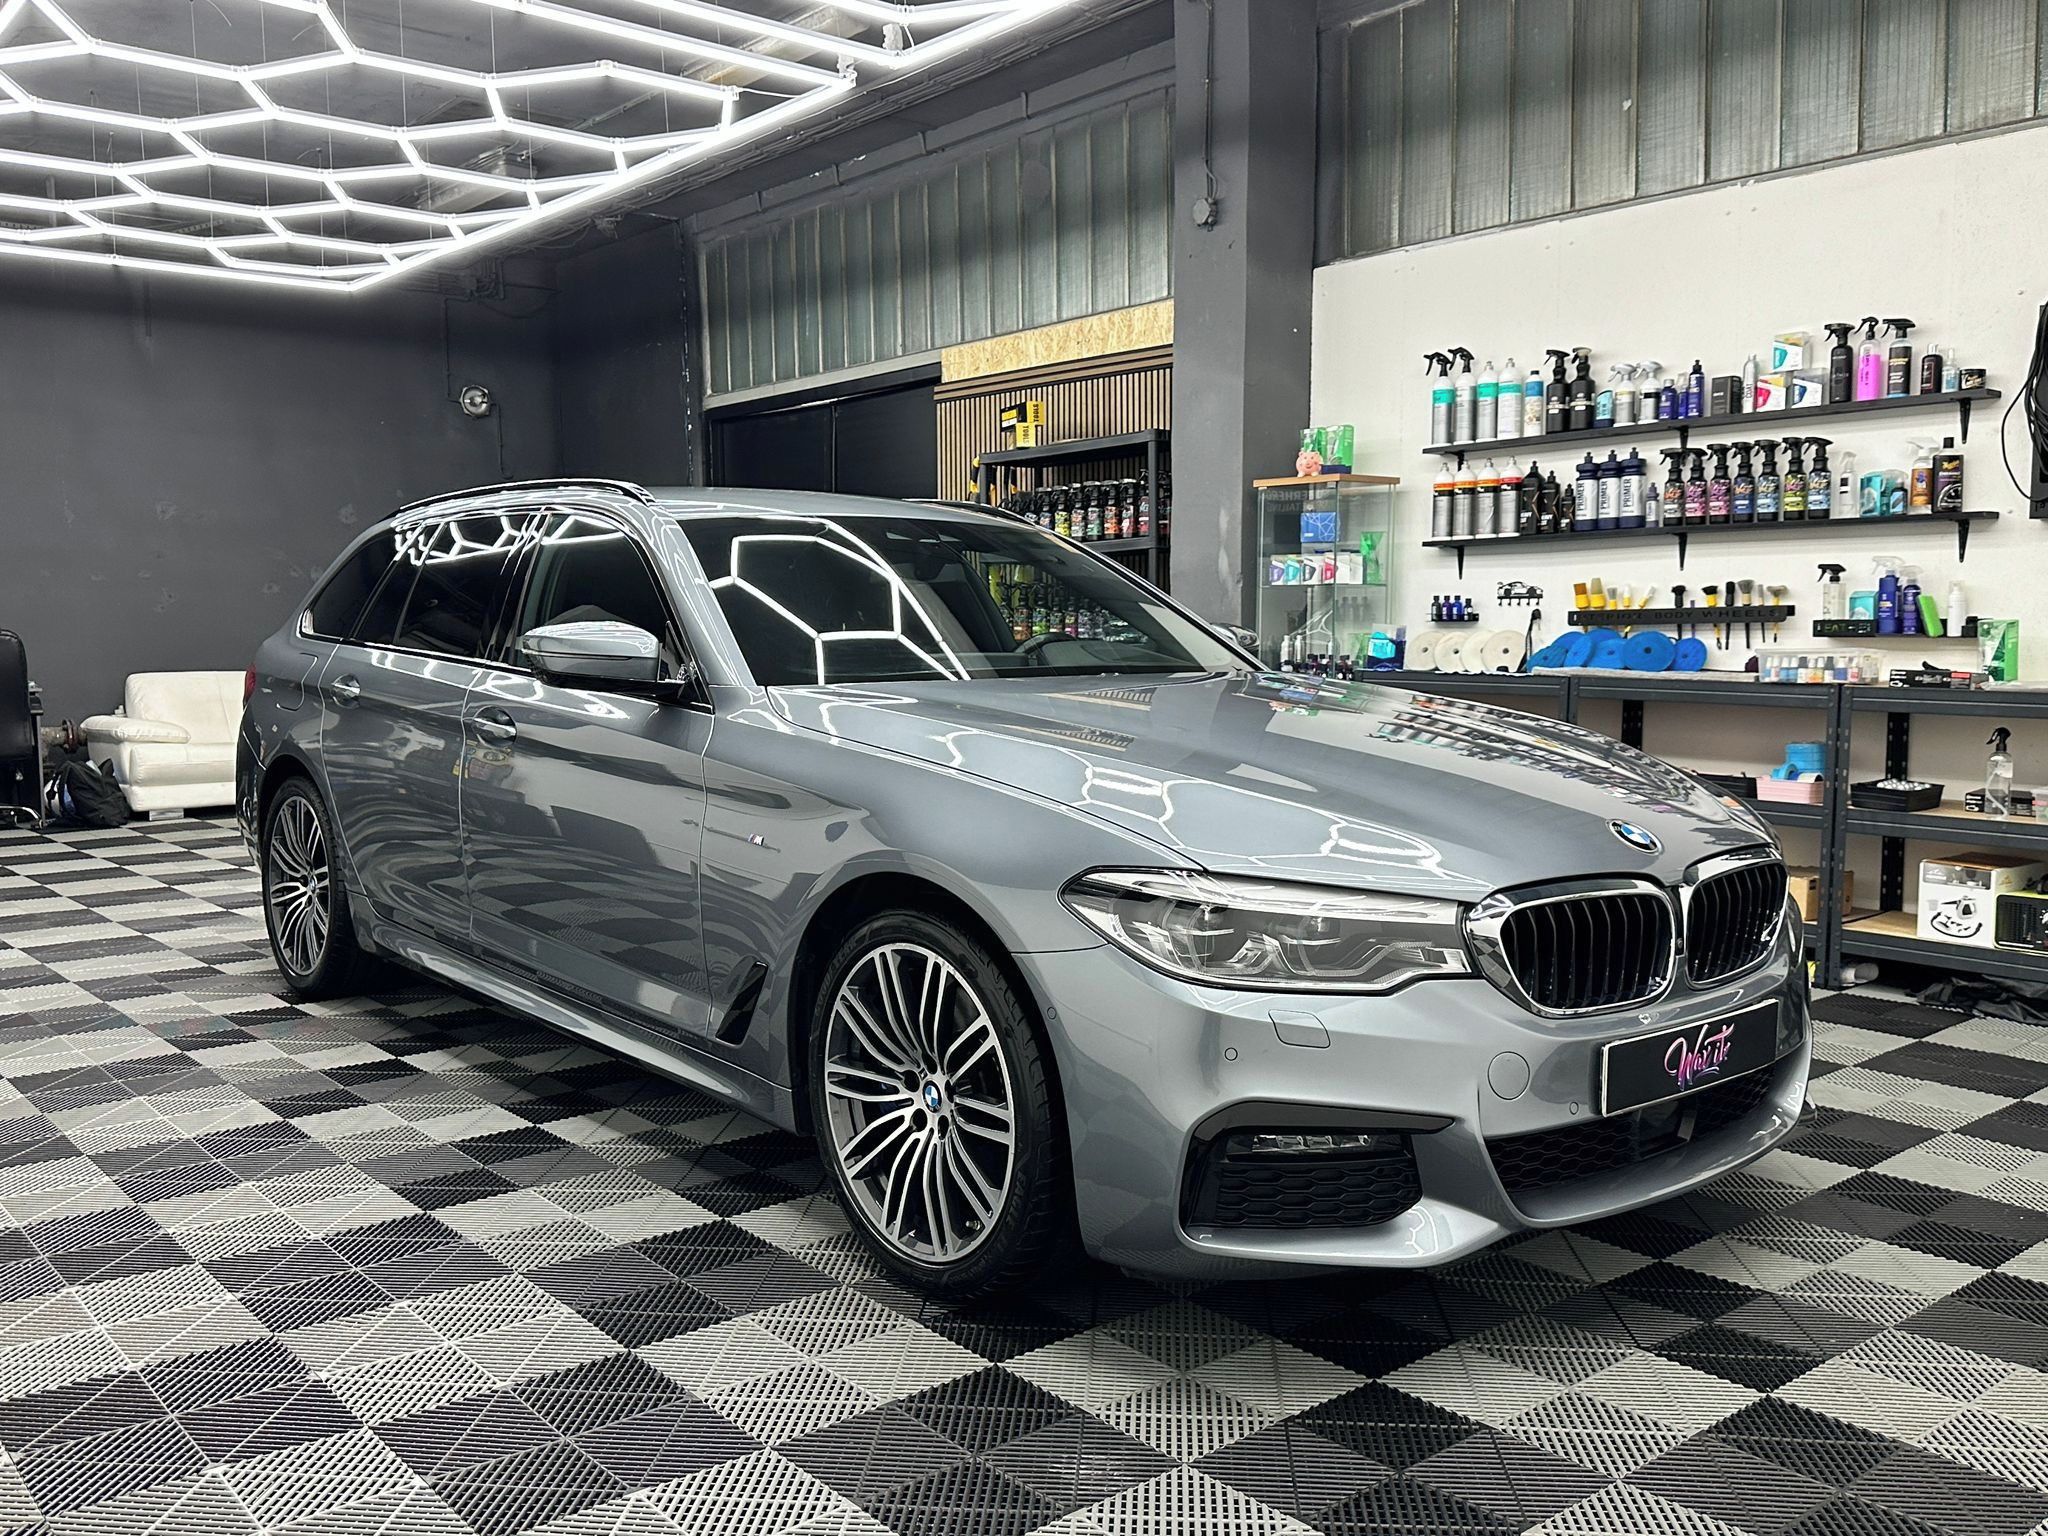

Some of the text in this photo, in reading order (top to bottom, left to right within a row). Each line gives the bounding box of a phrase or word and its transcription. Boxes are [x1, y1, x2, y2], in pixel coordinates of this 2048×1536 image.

[1032, 403, 1040, 422] TOOLS
[1576, 482, 1585, 512] PRIMER
[1600, 481, 1608, 510] PRIMER
[1623, 478, 1632, 508] PRIMER
[1654, 611, 1693, 620] BODY
[1701, 608, 1778, 619] WHEELS
